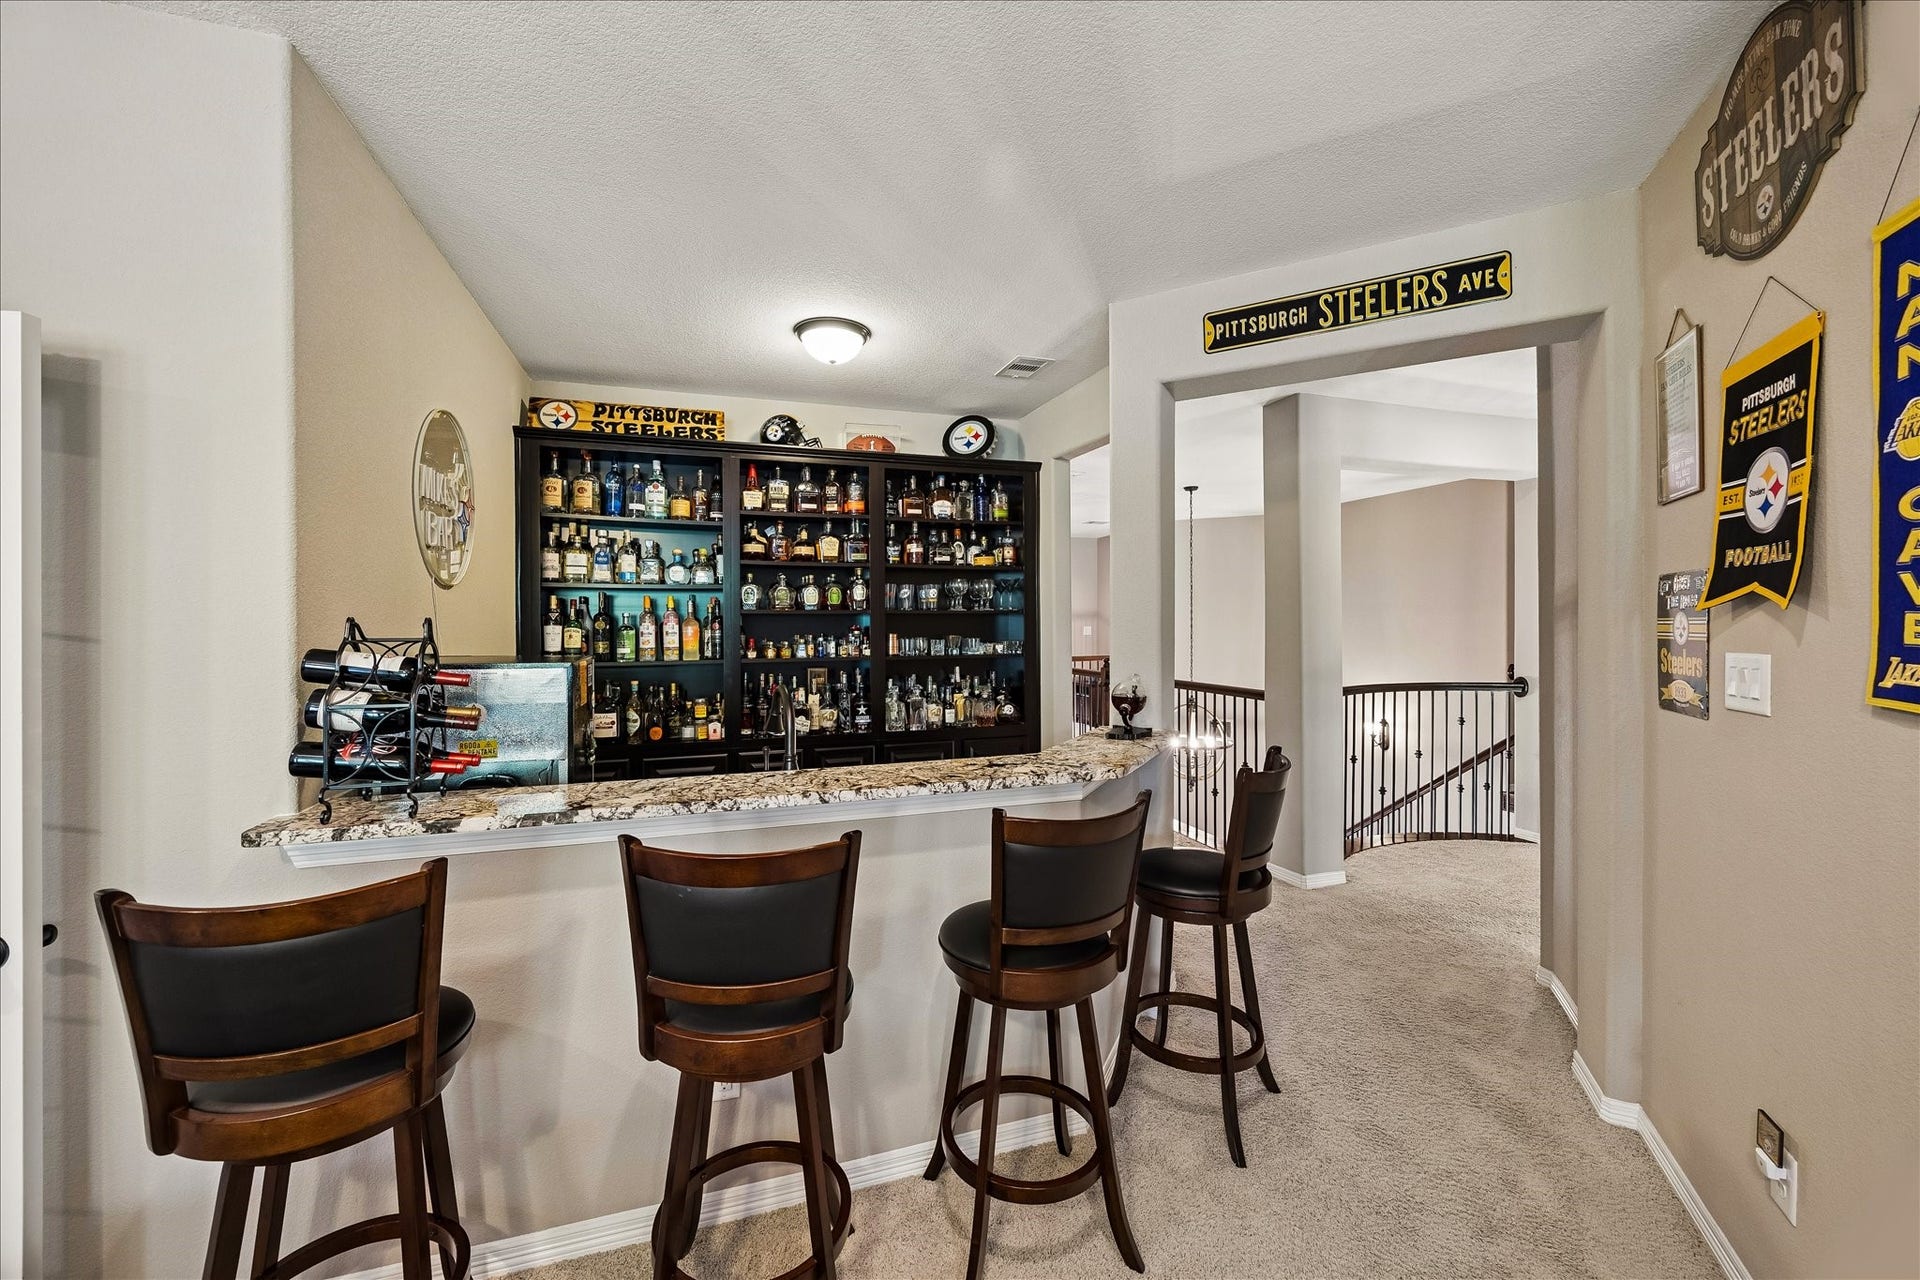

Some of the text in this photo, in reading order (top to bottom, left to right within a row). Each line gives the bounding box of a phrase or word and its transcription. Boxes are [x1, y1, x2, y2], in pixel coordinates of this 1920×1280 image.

[1701, 16, 1845, 228] STEELERS
[1783, 161, 1807, 213] FRIENDS
[1216, 268, 1495, 340] PITTSBURGH STEELERS AVE
[1742, 373, 1796, 412] PITTSBURGH
[591, 420, 718, 441] STEELERS
[592, 404, 718, 426] PITTSBURGH
[1729, 389, 1807, 446] STEELERS
[1723, 493, 1741, 506] EST.
[1749, 487, 1766, 498] Steelers
[1724, 540, 1792, 568] FOOTBALL
[1660, 647, 1703, 678] Steelers
